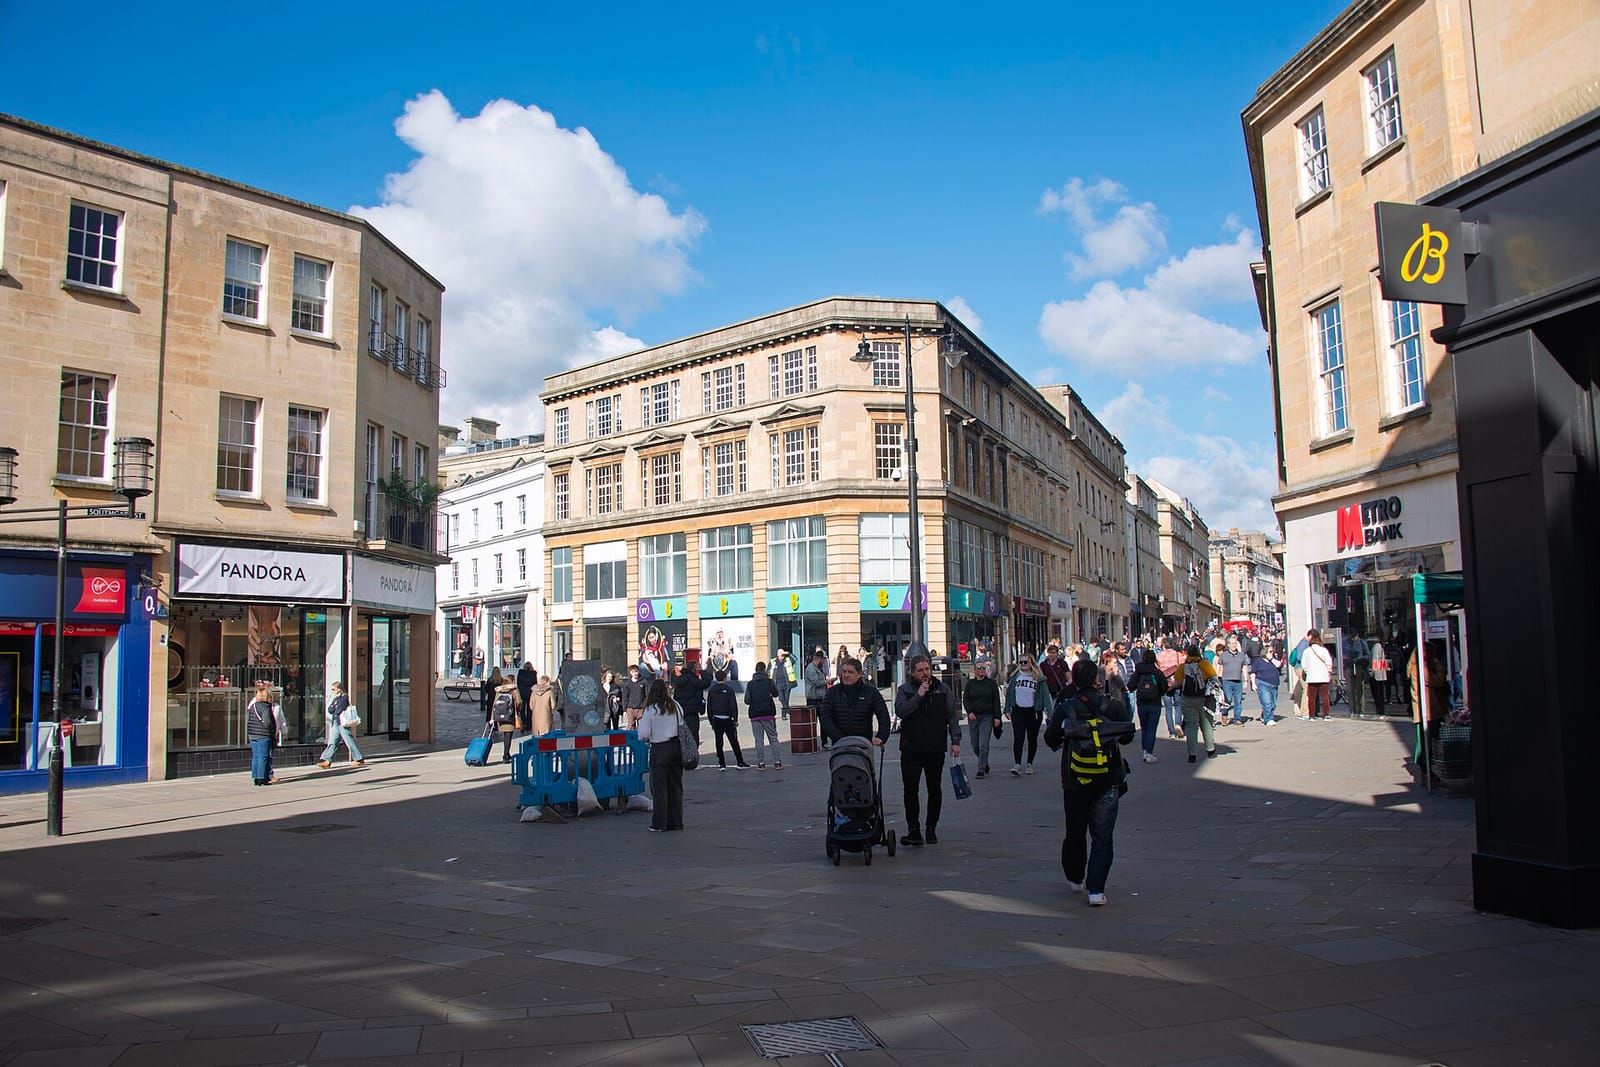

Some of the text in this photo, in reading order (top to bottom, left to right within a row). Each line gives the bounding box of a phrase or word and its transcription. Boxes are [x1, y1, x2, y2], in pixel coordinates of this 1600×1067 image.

[1400, 222, 1449, 285] B
[1336, 496, 1402, 553] METRO
[1364, 522, 1403, 546] BANK
[220, 562, 306, 582] PANDORA
[380, 575, 413, 593] PANDORA
